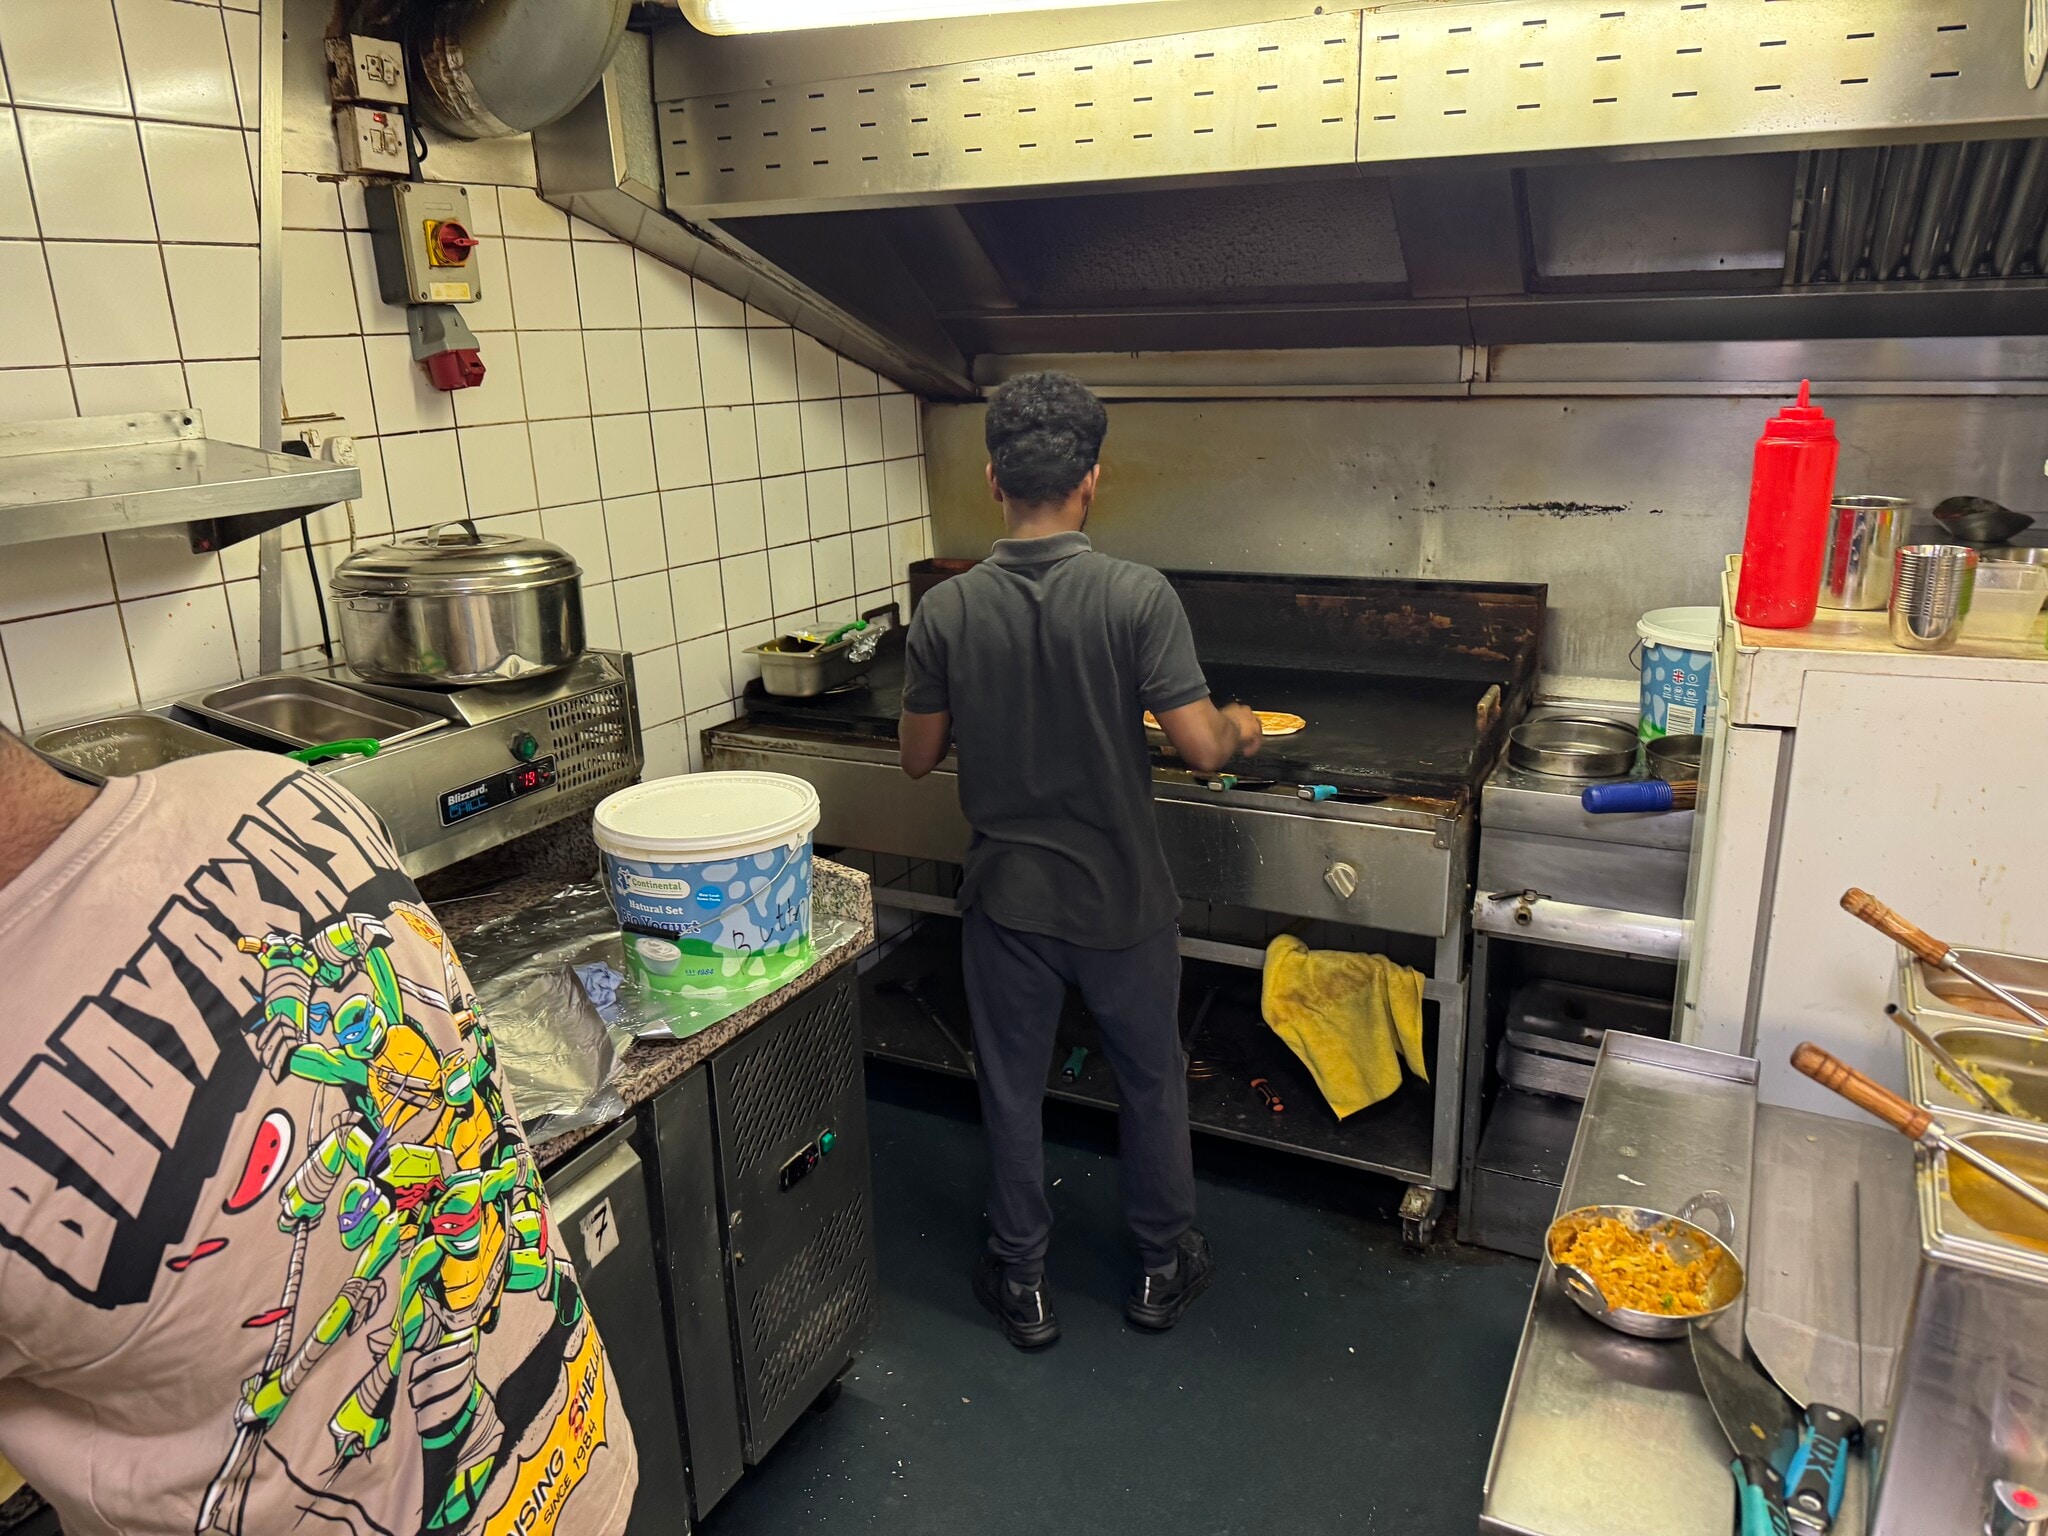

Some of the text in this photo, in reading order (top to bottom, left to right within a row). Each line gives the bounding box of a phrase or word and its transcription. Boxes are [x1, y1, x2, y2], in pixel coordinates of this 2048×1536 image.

[628, 899, 684, 915] Natural Set
[632, 878, 682, 891] Continental
[0, 770, 399, 1300] BOOYAKASH
[544, 1419, 597, 1524] SINCE 1984
